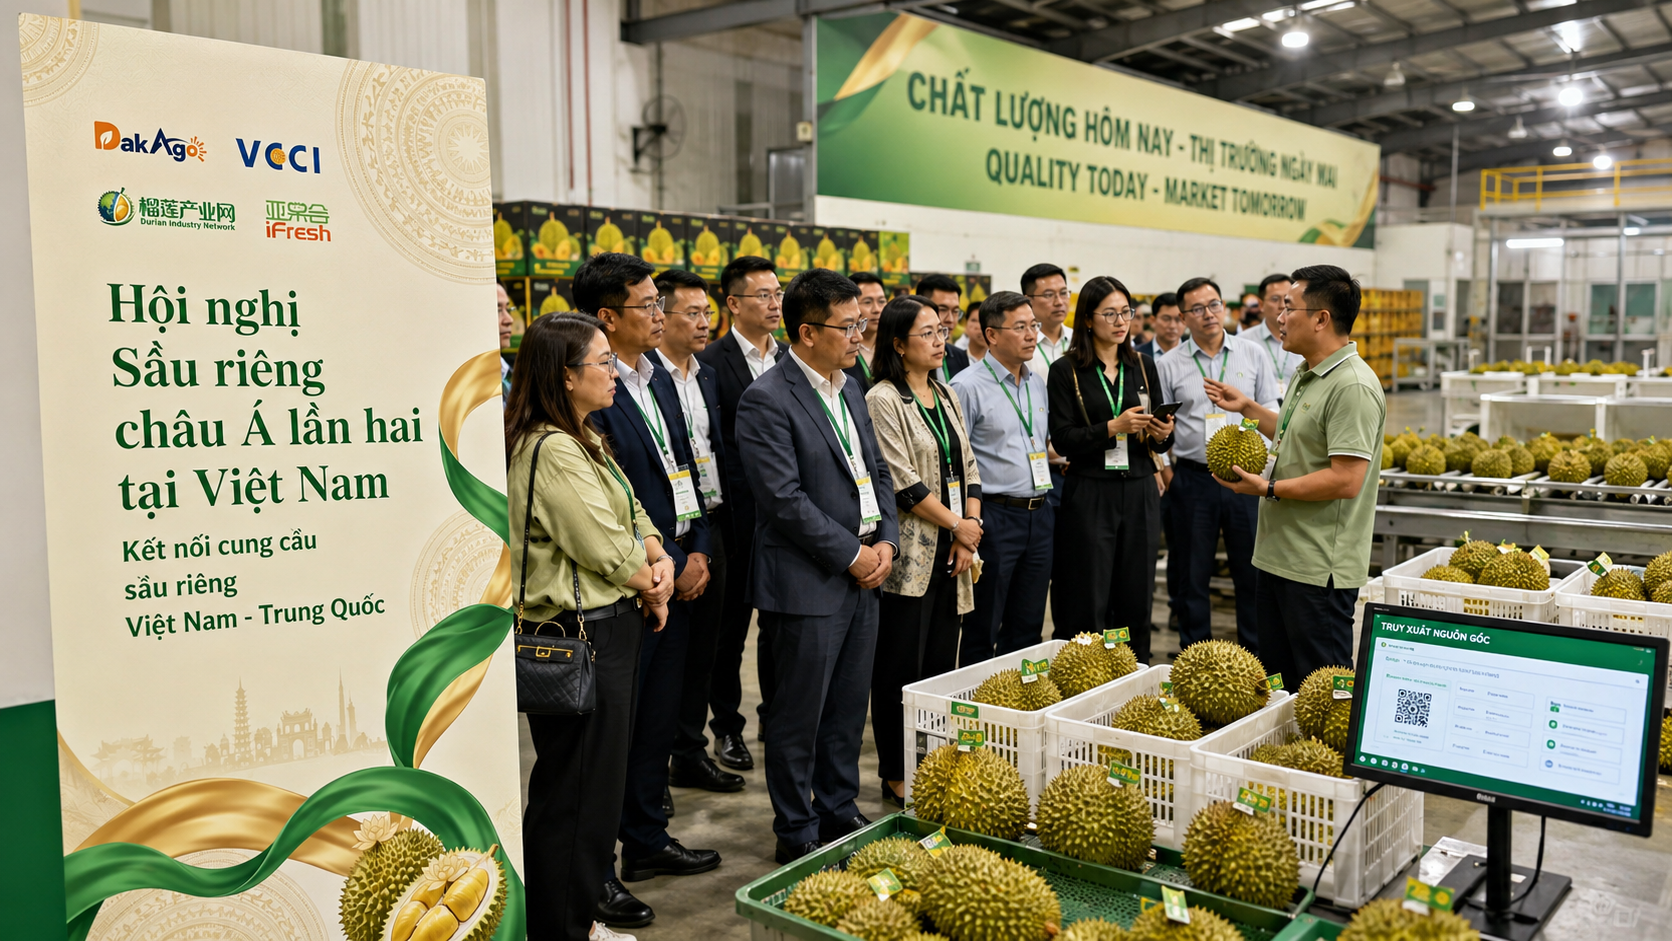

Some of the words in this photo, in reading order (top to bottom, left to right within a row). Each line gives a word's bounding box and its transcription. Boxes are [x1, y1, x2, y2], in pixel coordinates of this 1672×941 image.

[907, 68, 986, 122] CHẤT
[996, 90, 1077, 142] LƯỢNG
[1085, 106, 1130, 150] HÔM
[1137, 122, 1174, 157] NAY
[1190, 134, 1215, 173] THỊ
[1317, 161, 1338, 189] MAI
[235, 138, 321, 174] VCCI
[986, 147, 1080, 193] QUALITY
[1087, 164, 1148, 201] TODAY
[1164, 176, 1227, 212] MARKET
[1232, 186, 1308, 222] TOMORROW
[139, 197, 236, 224] 榴莲产业网
[141, 217, 167, 227] Durian
[169, 219, 201, 230] Industry
[203, 221, 236, 231] Network
[265, 221, 332, 242] iFresh
[107, 283, 191, 334] Hội
[205, 289, 301, 337] nghị
[112, 341, 200, 388] Sầu
[214, 349, 326, 397] riêng
[115, 409, 227, 450] châu
[241, 399, 276, 447] Á
[288, 402, 352, 445] lần
[363, 407, 424, 443] hai
[118, 470, 180, 520] tại
[193, 467, 285, 514] Việt
[296, 465, 390, 503] Nam
[122, 537, 166, 562] Kết
[174, 534, 211, 559] nối
[218, 537, 273, 558] cung
[279, 528, 317, 552] cầu
[125, 575, 168, 601] sầu
[176, 573, 238, 597] riêng
[125, 614, 177, 641] Việt
[184, 611, 238, 633] Nam
[258, 604, 325, 626] Trung
[331, 592, 386, 621] Quốc
[1381, 621, 1406, 633] TRUY
